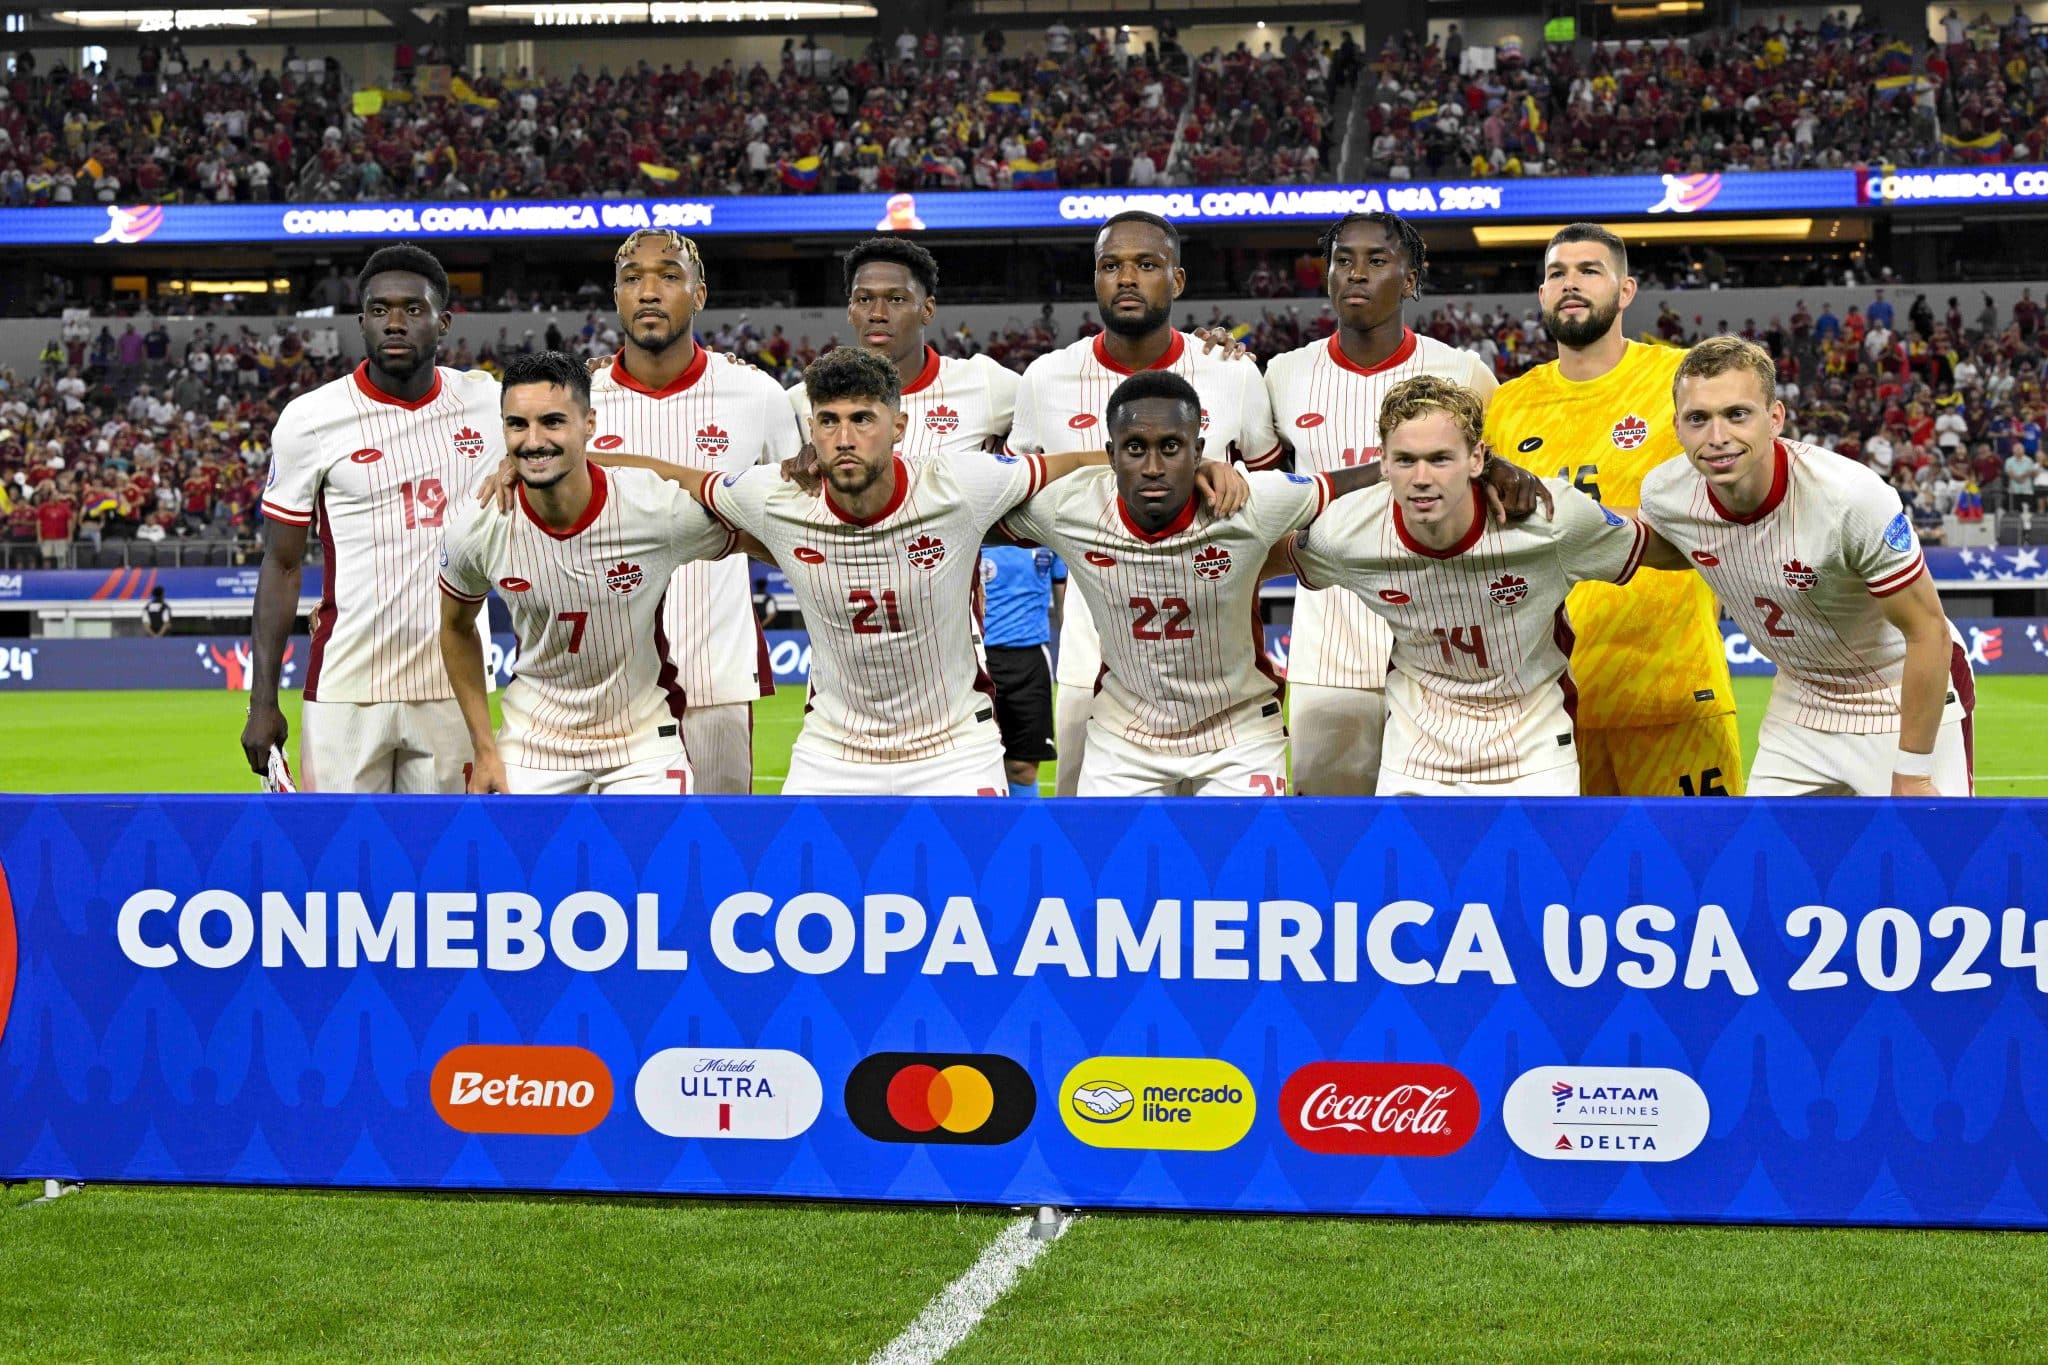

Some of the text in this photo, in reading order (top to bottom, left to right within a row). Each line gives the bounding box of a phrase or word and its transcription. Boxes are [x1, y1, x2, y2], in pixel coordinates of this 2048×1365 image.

[1200, 192, 1270, 216] COPA
[1270, 190, 1384, 214] AMERICA
[1387, 187, 1437, 211] USA
[1439, 186, 1501, 210] 2024
[283, 203, 712, 234] CONMEBOL COPA AMERICA USA 2024
[925, 416, 959, 424] CANADA
[696, 437, 730, 445] CANADA
[1612, 428, 1647, 437] CANADA
[454, 438, 484, 448] CANADA
[400, 478, 448, 530] 19
[907, 545, 945, 561] CANADA
[1193, 557, 1232, 570] CANADA
[606, 571, 643, 585] CANADA
[1783, 570, 1818, 581] CANADA
[1489, 583, 1529, 596] CANADA
[848, 590, 901, 634] 21
[1129, 597, 1195, 640] 22
[1754, 597, 1794, 637] 2
[558, 612, 588, 654] 7
[1433, 625, 1489, 668] 14
[117, 889, 2048, 996] CONMEBOL COPA AMERICA USA 2024
[693, 1057, 757, 1074] Michelob
[450, 1071, 595, 1108] Betano
[681, 1076, 773, 1098] ULTRA
[1143, 1084, 1243, 1104] mercado
[1579, 1086, 1659, 1101] LATAM
[1143, 1103, 1192, 1123] libre
[1579, 1105, 1659, 1116] AIRLINES
[1581, 1136, 1657, 1151] DELTA
